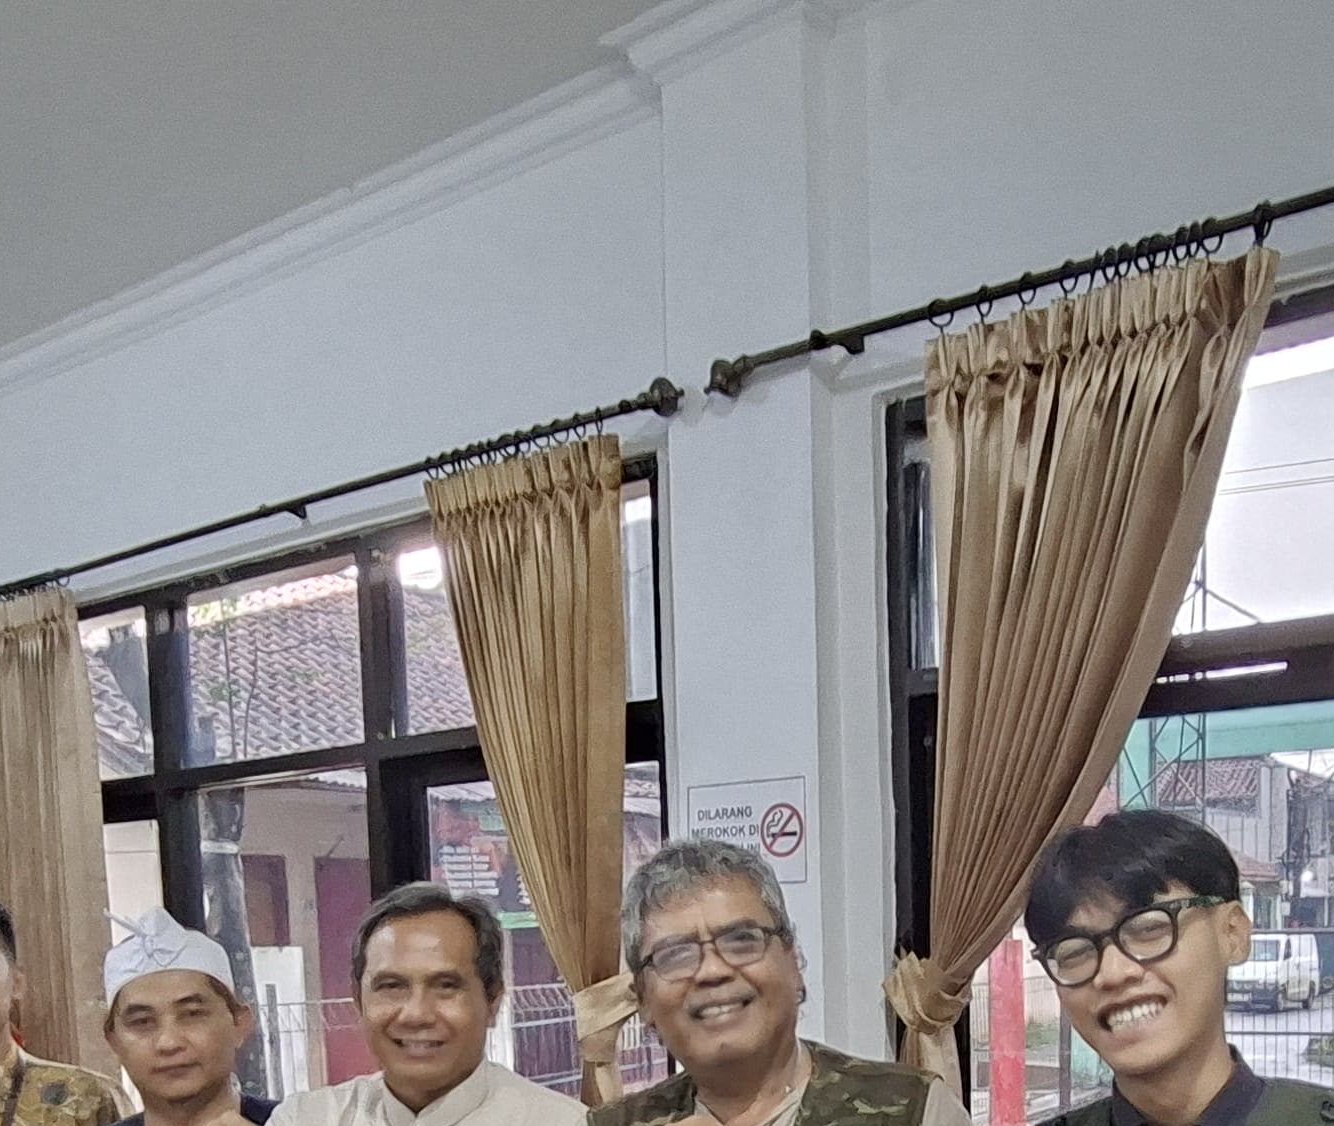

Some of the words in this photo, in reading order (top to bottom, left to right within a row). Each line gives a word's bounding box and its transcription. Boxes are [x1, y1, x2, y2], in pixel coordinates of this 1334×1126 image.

[697, 806, 753, 821] DILARANG
[691, 825, 746, 839] MEROKOK
[748, 823, 759, 836] DI
